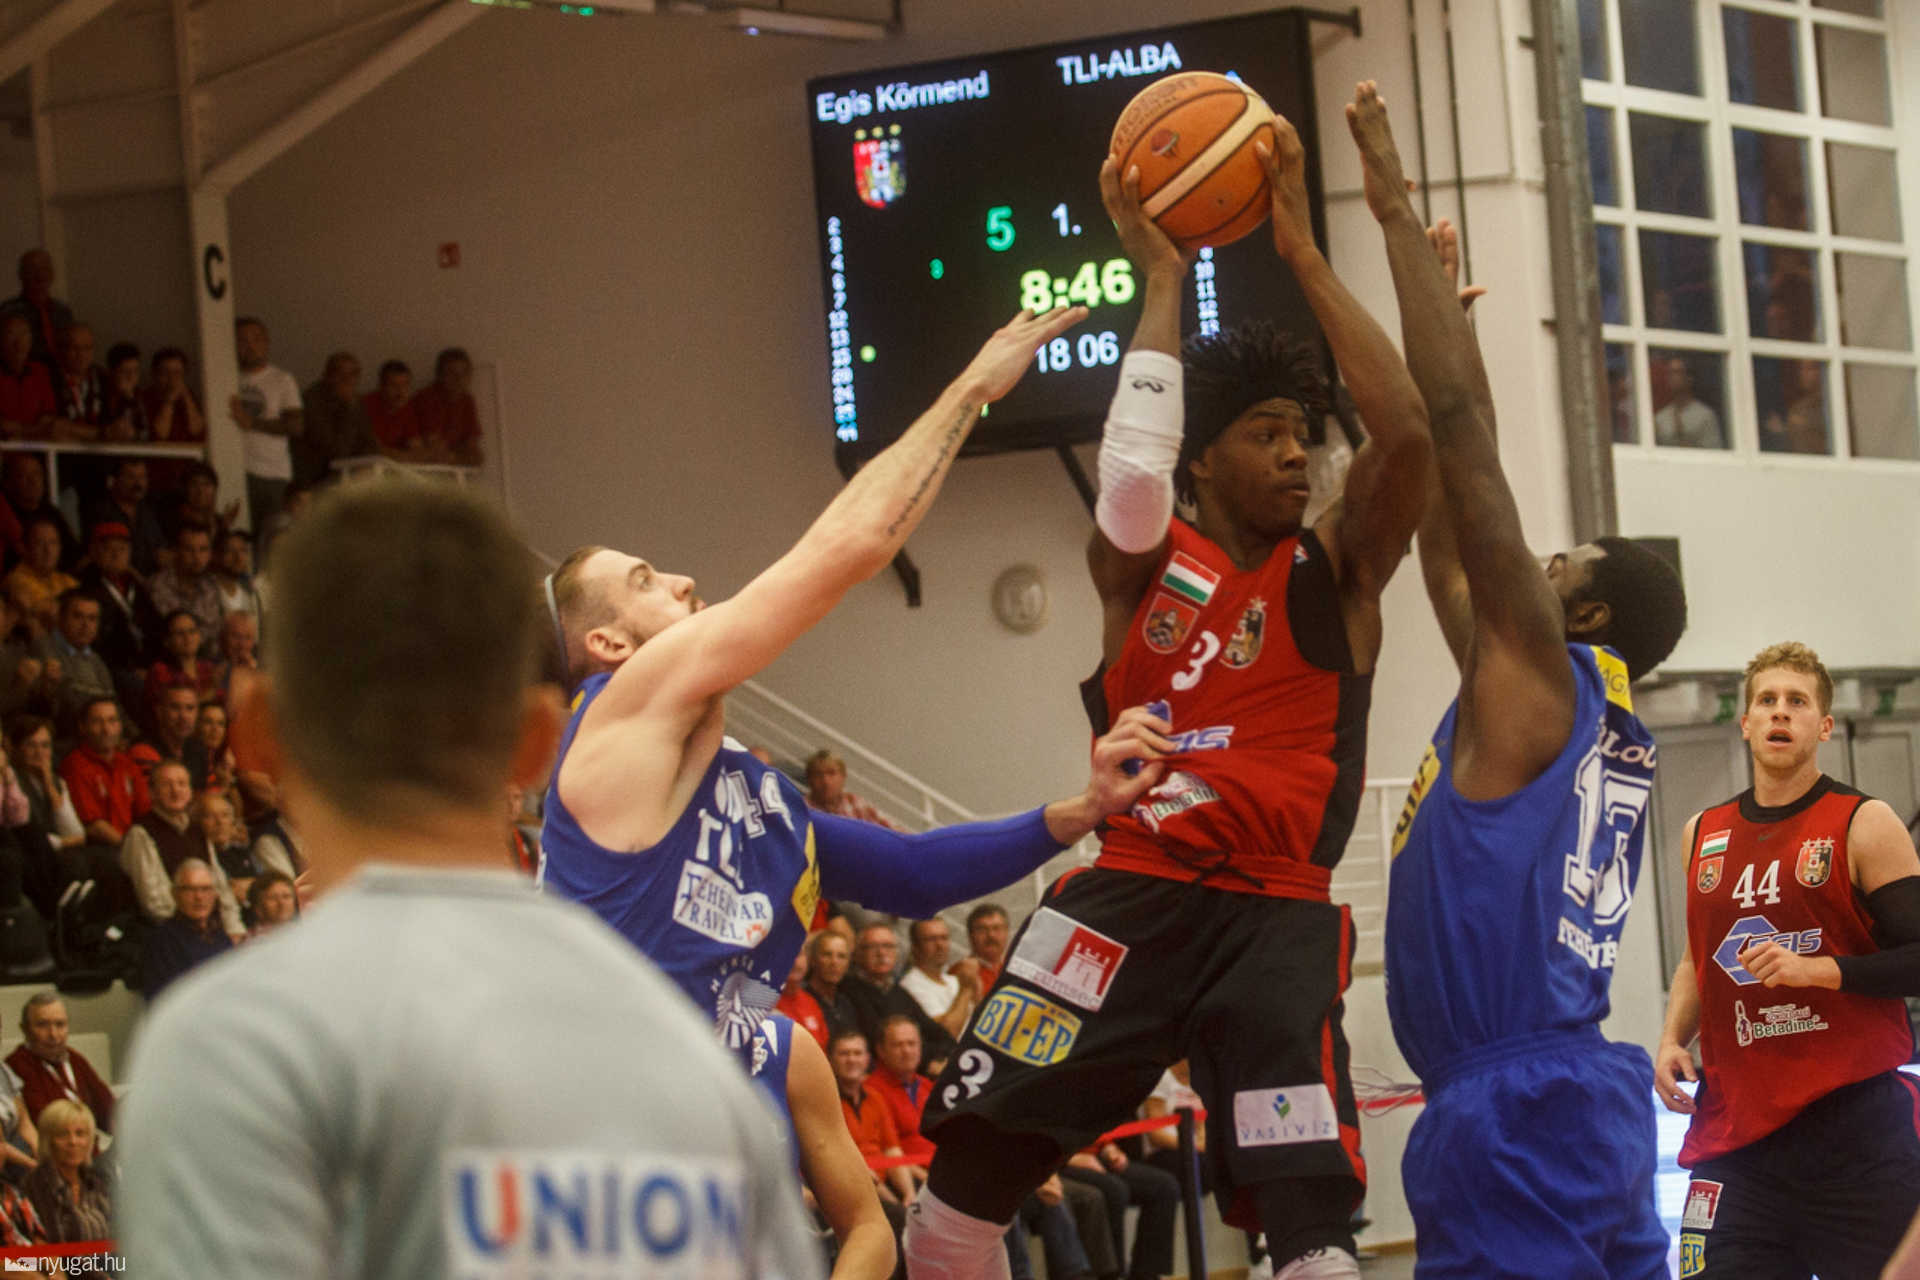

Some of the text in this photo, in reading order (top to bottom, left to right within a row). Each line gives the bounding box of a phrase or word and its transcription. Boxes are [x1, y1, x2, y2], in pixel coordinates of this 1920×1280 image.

[1055, 41, 1182, 86] TLI-ALBA
[816, 69, 990, 124] Egis Körmend
[986, 206, 1016, 252] 5
[1052, 203, 1082, 237] 1.
[203, 244, 226, 300] C
[1020, 258, 1136, 315] 8:46
[1035, 331, 1120, 373] 18 06
[1171, 630, 1221, 691] 3
[1732, 860, 1780, 908] 44
[976, 990, 1073, 1064] BIT-EP
[458, 1165, 743, 1257] UNION
